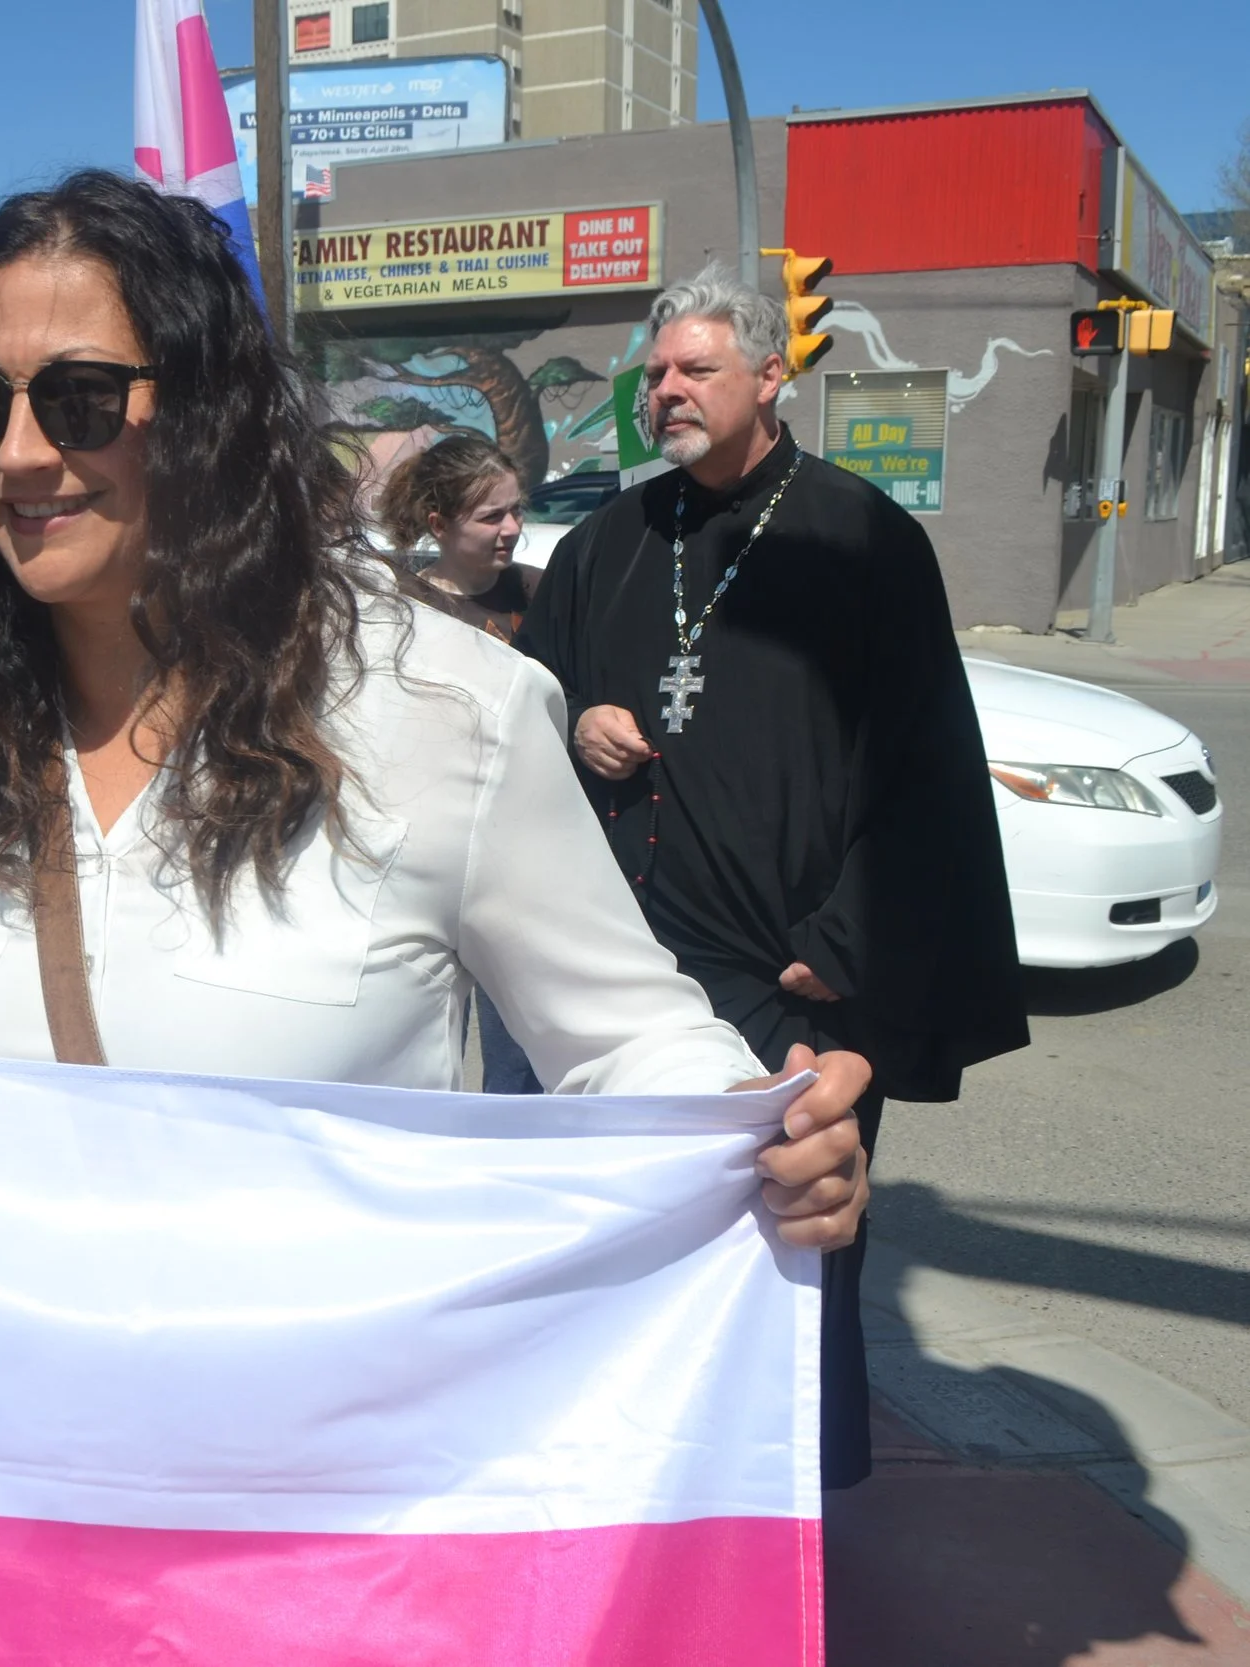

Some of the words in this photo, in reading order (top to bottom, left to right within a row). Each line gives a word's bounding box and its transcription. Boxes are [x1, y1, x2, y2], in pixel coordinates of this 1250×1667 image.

[321, 83, 379, 98] WESTJET
[318, 105, 406, 124] Minneapolis
[422, 104, 462, 118] Delta
[310, 128, 336, 141] 70+
[340, 127, 361, 140] US
[364, 124, 406, 139] Cities
[578, 217, 614, 236] DINE
[618, 216, 635, 233] IN
[385, 219, 550, 259] RESTAURANT
[569, 241, 609, 259] TAKE
[612, 238, 644, 256] OUT
[294, 267, 372, 284] IETNAMESE,
[380, 261, 432, 279] CHINESE
[439, 260, 449, 273] &
[456, 257, 489, 273] THAI
[496, 252, 549, 270] CUISINE
[569, 260, 641, 281] DELIVERY
[324, 289, 334, 300] &
[343, 280, 441, 299] VEGETARIAN
[452, 275, 508, 292] MEALS
[853, 423, 873, 443] All
[878, 423, 908, 445] Day
[834, 456, 874, 473] Now
[880, 454, 929, 472] We're
